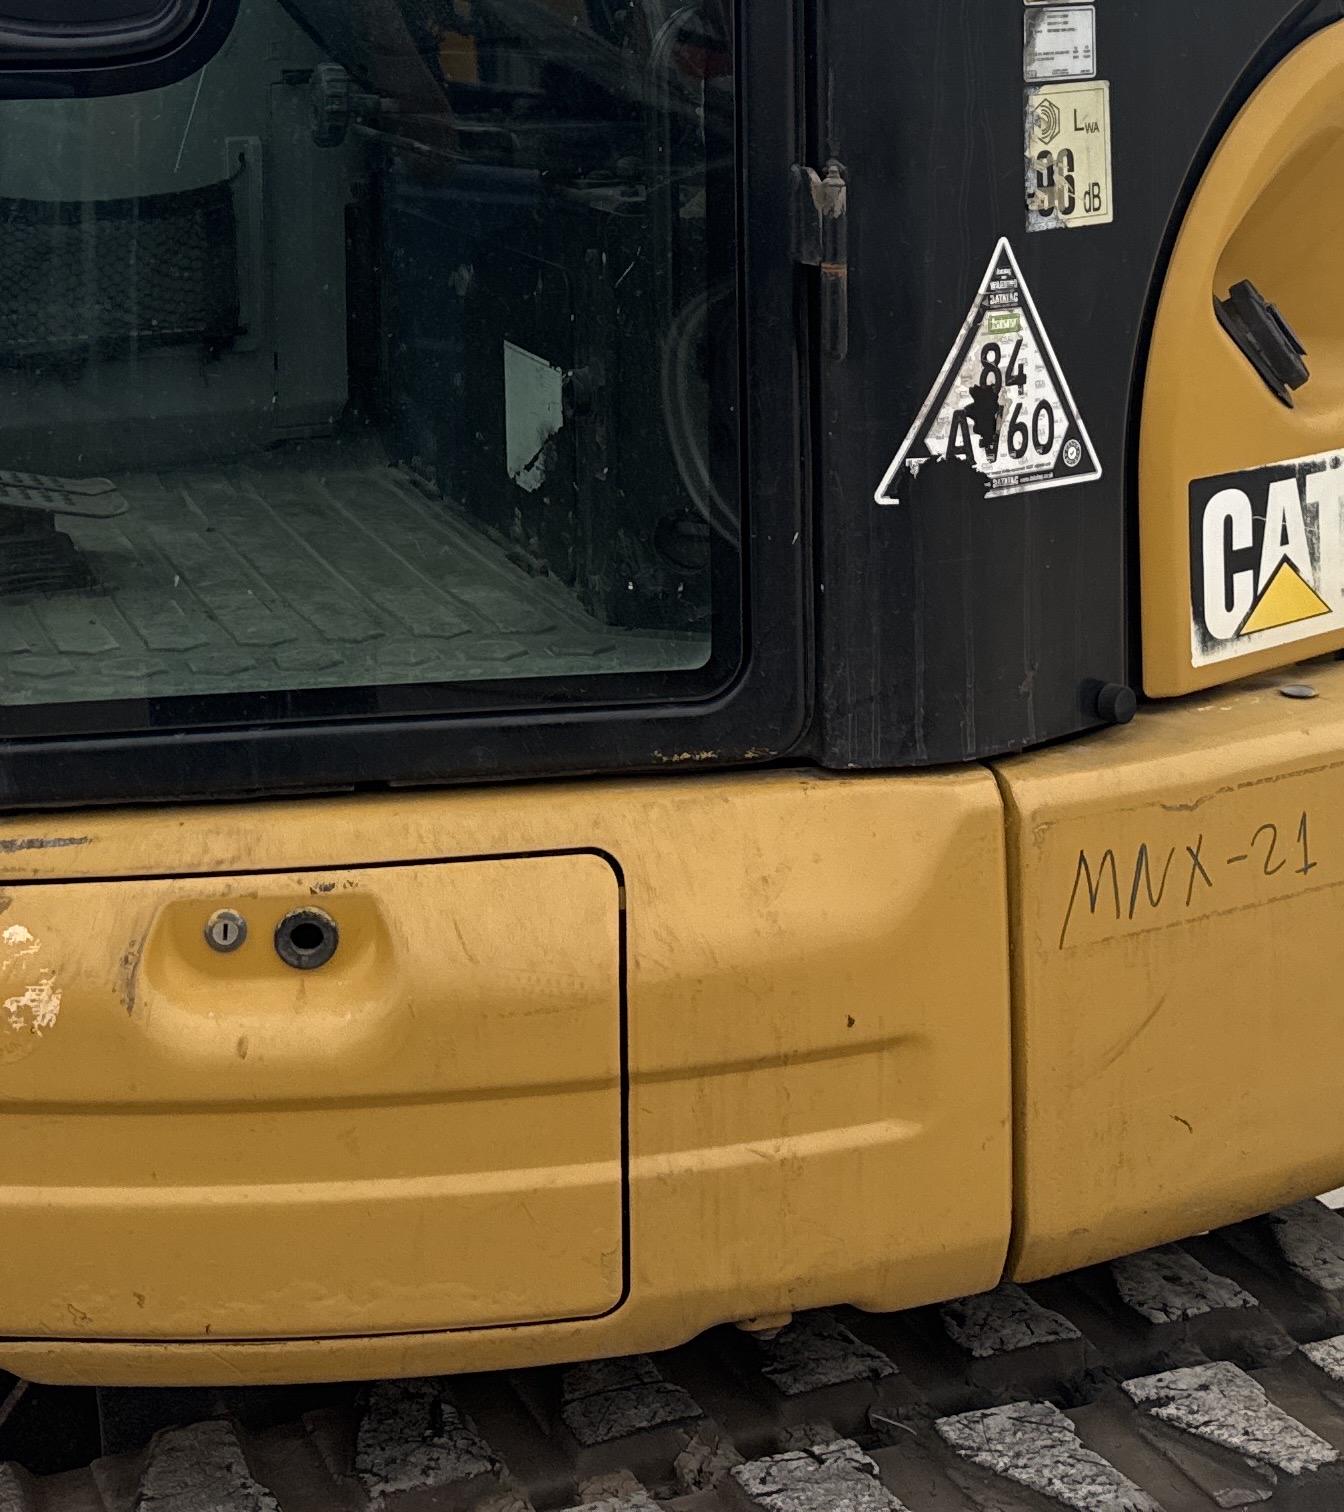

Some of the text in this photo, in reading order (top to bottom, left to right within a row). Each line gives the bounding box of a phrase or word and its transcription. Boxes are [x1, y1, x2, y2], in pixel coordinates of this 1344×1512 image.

[1083, 181, 1102, 214] dB
[979, 339, 1027, 396] 84
[1058, 809, 1318, 951] MNX-21
